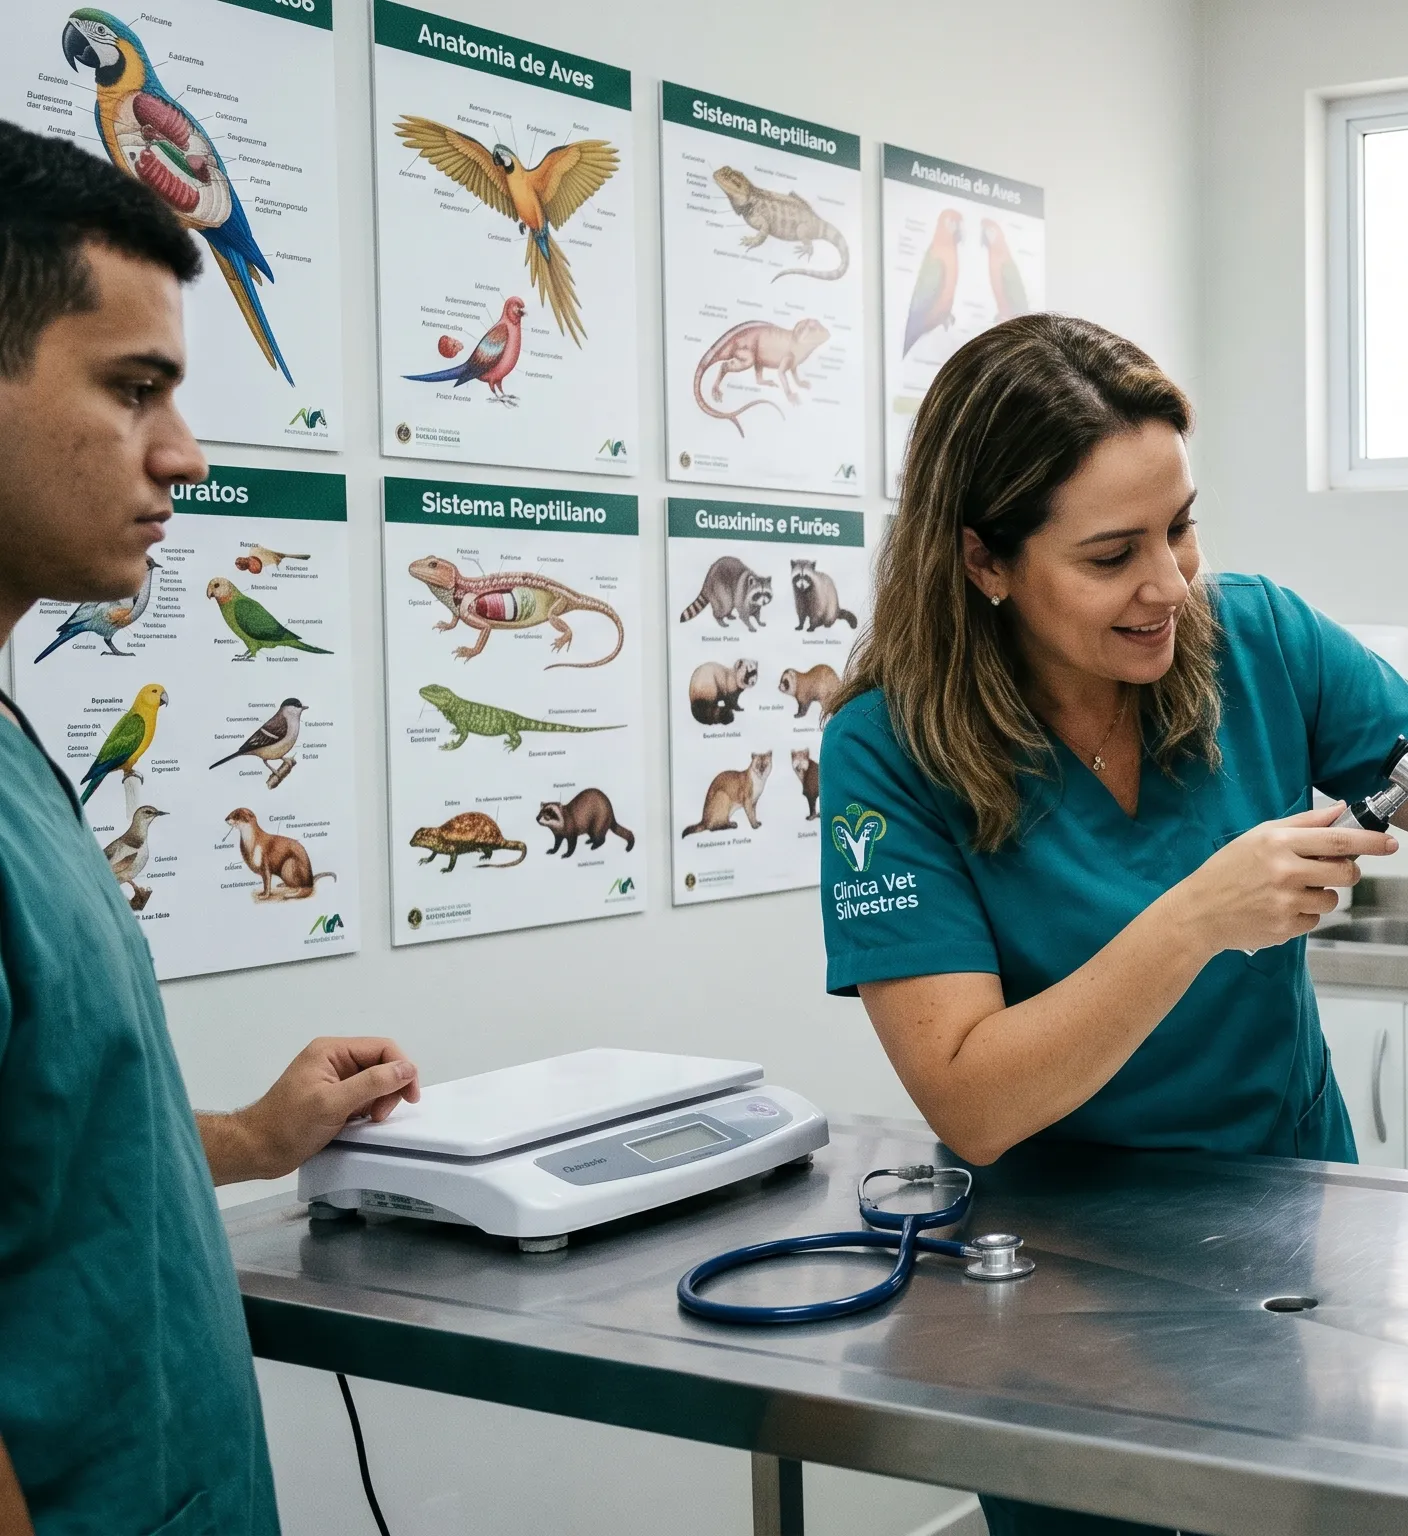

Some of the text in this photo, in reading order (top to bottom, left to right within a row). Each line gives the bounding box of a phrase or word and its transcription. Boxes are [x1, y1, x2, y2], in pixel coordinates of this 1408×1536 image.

[417, 23, 594, 90] Anatomia de Aves
[692, 99, 837, 155] Sistema Reptiliano
[973, 179, 990, 197] de
[992, 183, 1021, 205] Aves
[422, 491, 607, 525] Sistema Reptiliano
[695, 509, 841, 537] Guaxinins e Furões
[833, 872, 917, 901] Clinica Vet
[836, 894, 919, 921] Silvestres
